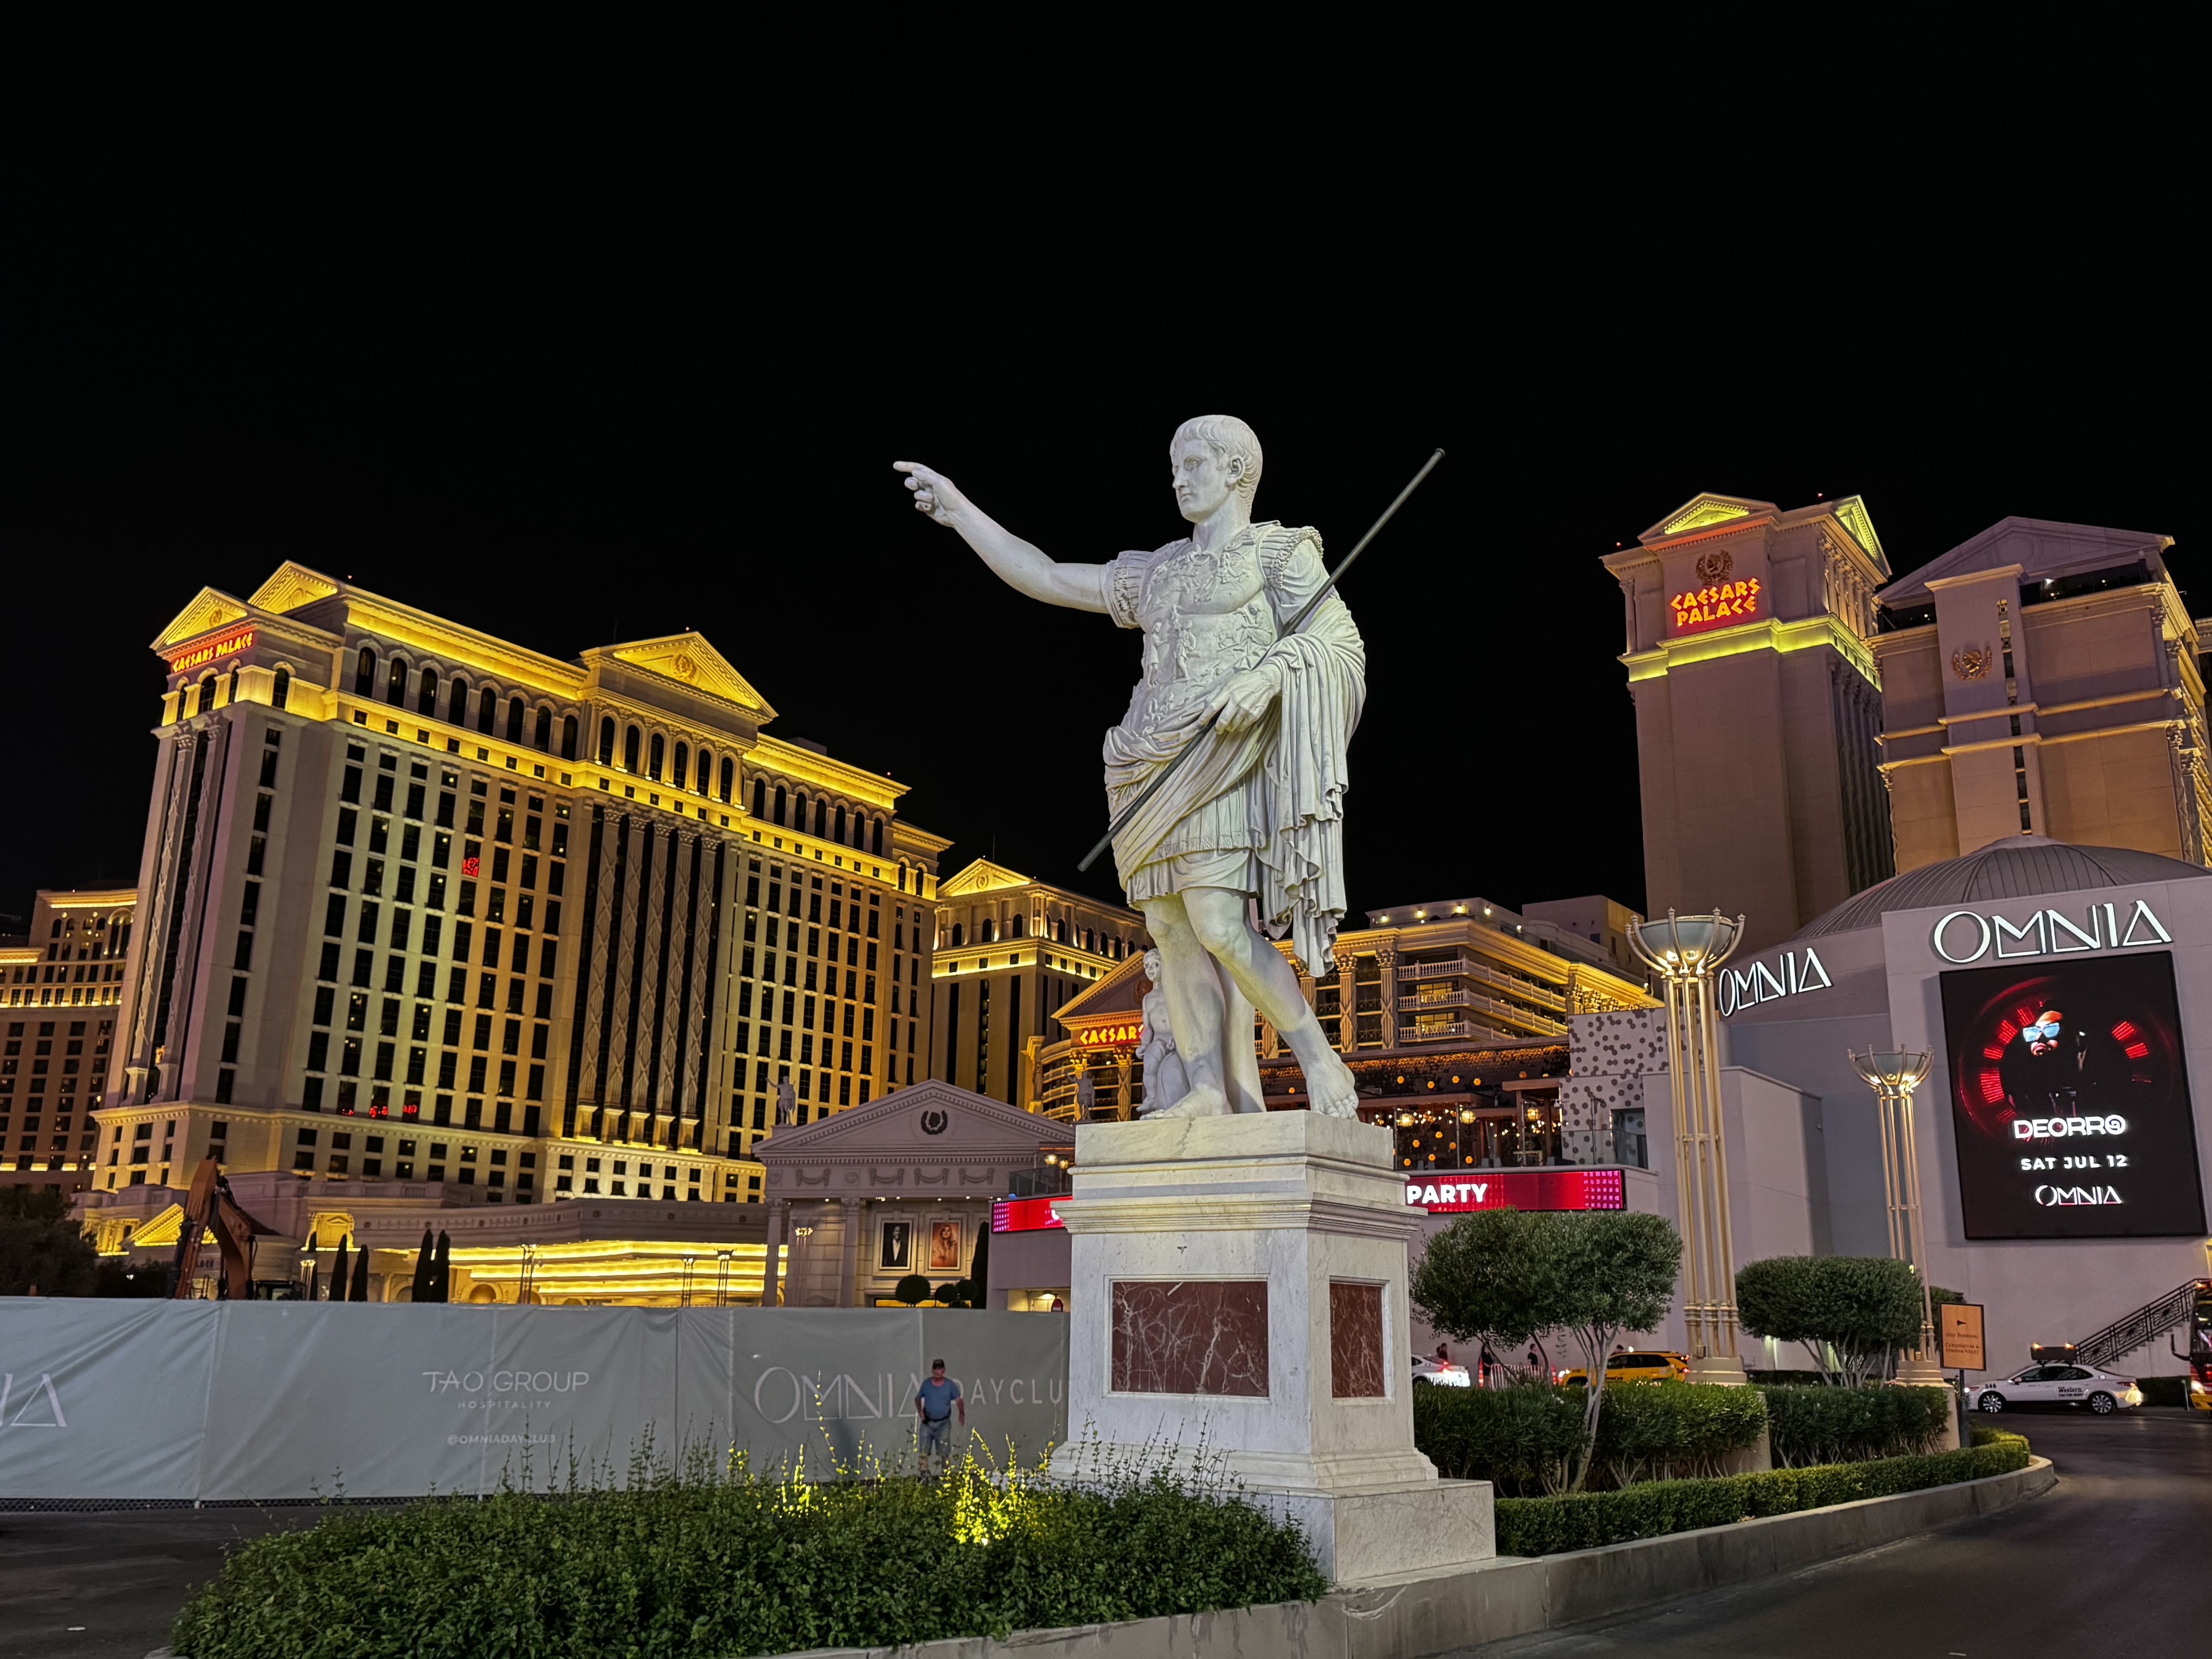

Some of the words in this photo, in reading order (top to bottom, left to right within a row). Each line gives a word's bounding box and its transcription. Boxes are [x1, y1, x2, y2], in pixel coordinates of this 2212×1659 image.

[1670, 577, 1761, 611] CAESARS
[1676, 595, 1756, 627] PALACE
[172, 646, 214, 673] CAESARS
[215, 632, 253, 658] PALACE
[1934, 900, 2172, 963] OMNIA
[1719, 947, 1832, 1017] OMNIA
[2021, 1157, 2056, 1171] SAT
[2063, 1156, 2101, 1169] JUL
[2107, 1155, 2128, 1167] 12
[1407, 1183, 1488, 1204] PARTY
[2035, 1185, 2123, 1206] OMNIA
[422, 1369, 484, 1393] TAO
[493, 1371, 589, 1392] GROUP
[457, 1400, 551, 1409] HOSPITALITY
